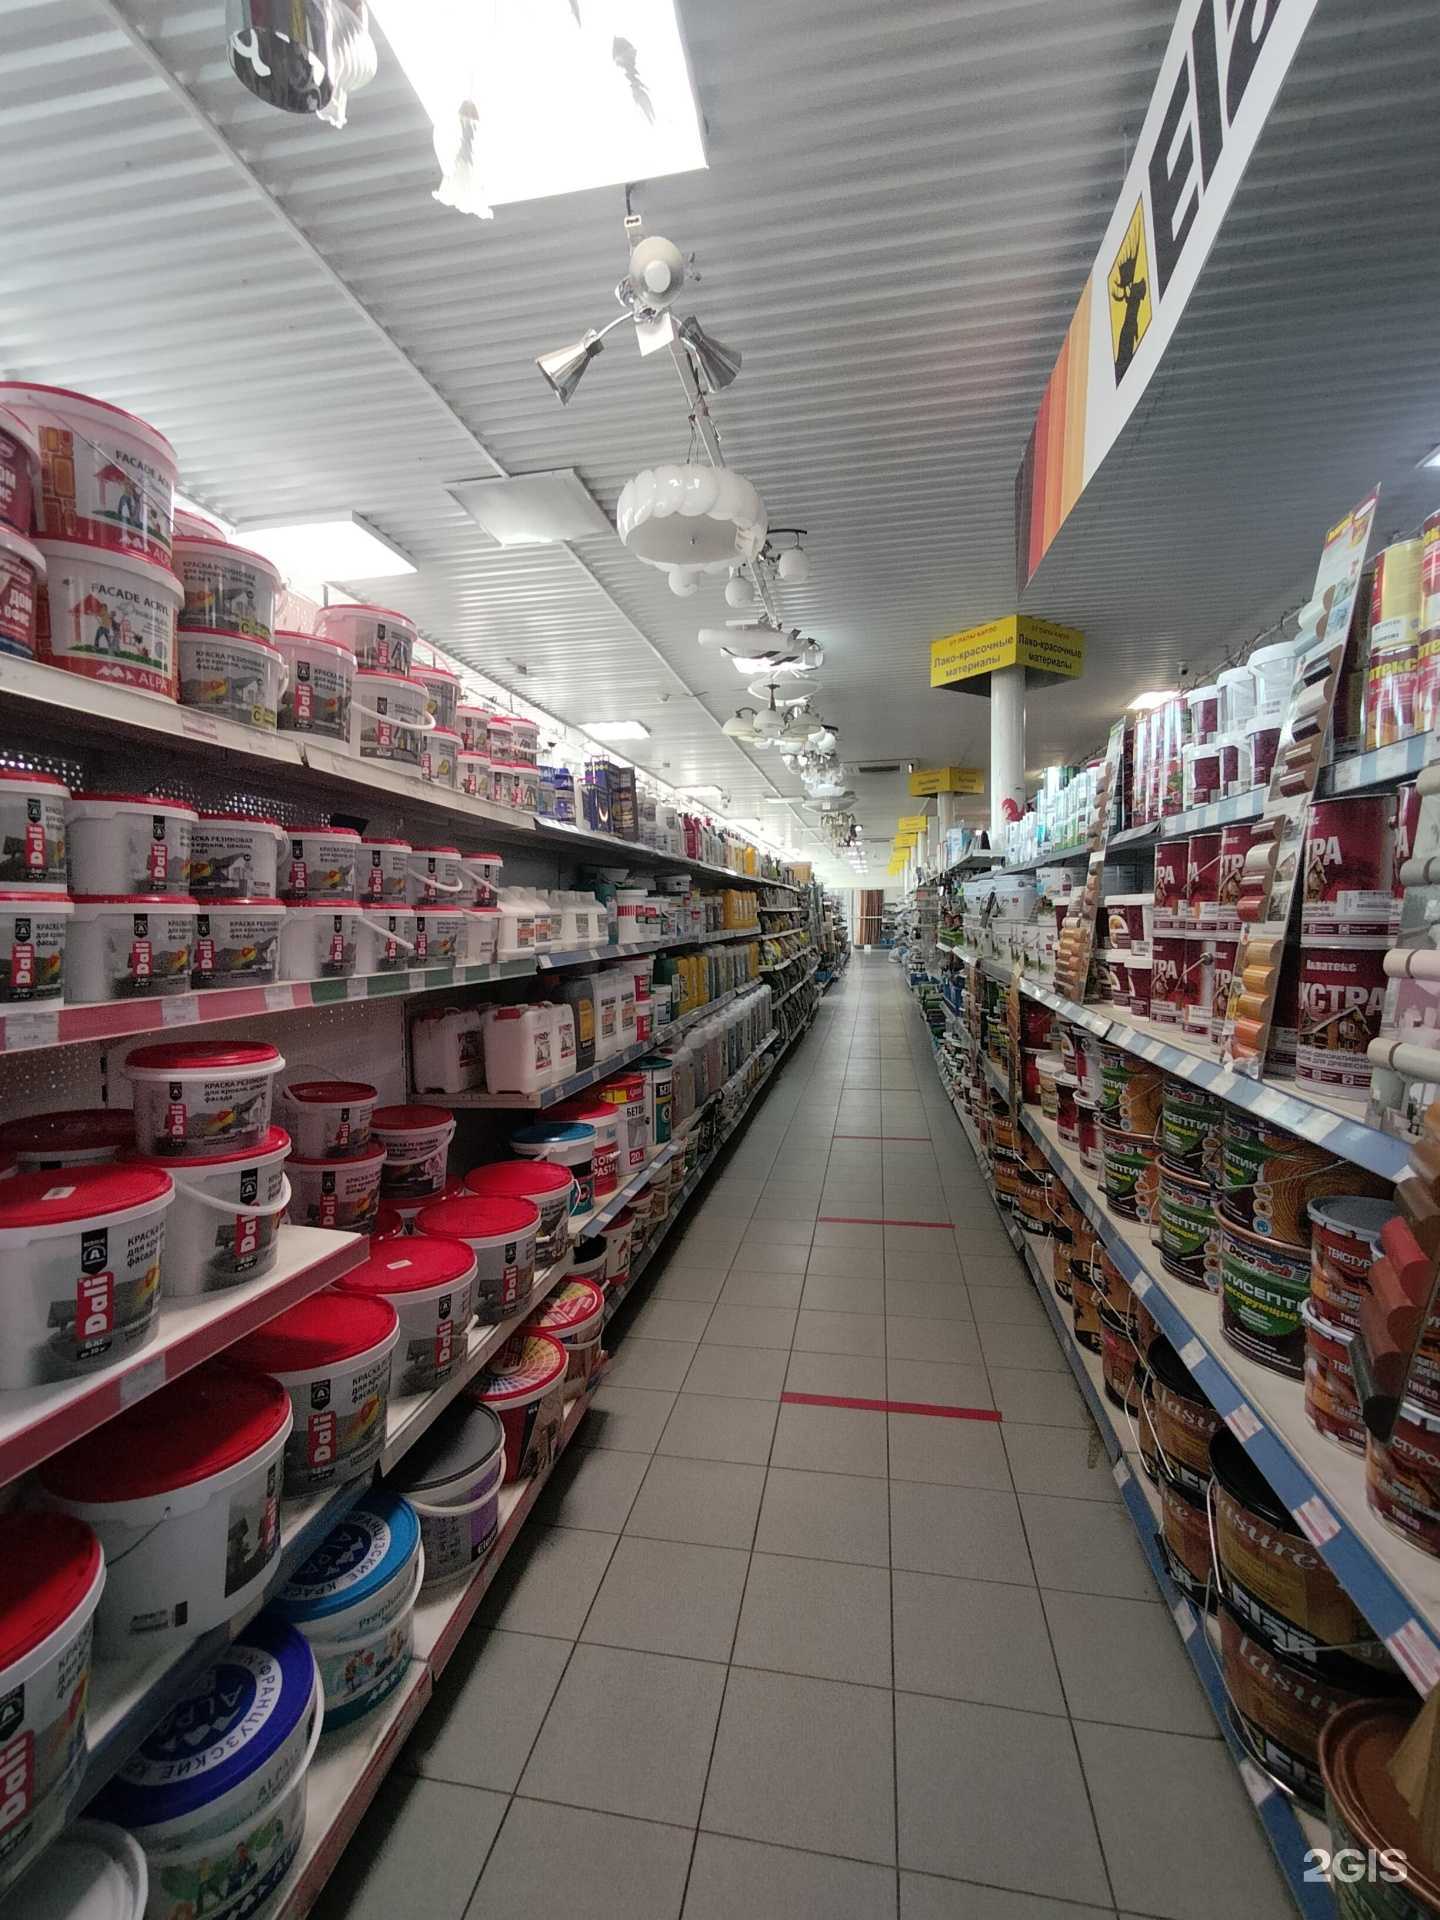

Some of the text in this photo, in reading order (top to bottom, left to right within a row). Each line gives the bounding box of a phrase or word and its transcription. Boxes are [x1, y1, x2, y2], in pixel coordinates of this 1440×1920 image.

[91, 583, 141, 604] FACADE
[933, 636, 1014, 668] Лако-красочные
[1018, 633, 1082, 659] Лако-красочные
[945, 654, 1001, 677] материалы
[1028, 652, 1073, 671] материалы
[139, 672, 169, 691] ALPA
[15, 945, 32, 984] Dali
[83, 1275, 108, 1336] Dali
[313, 1412, 333, 1460] Dali
